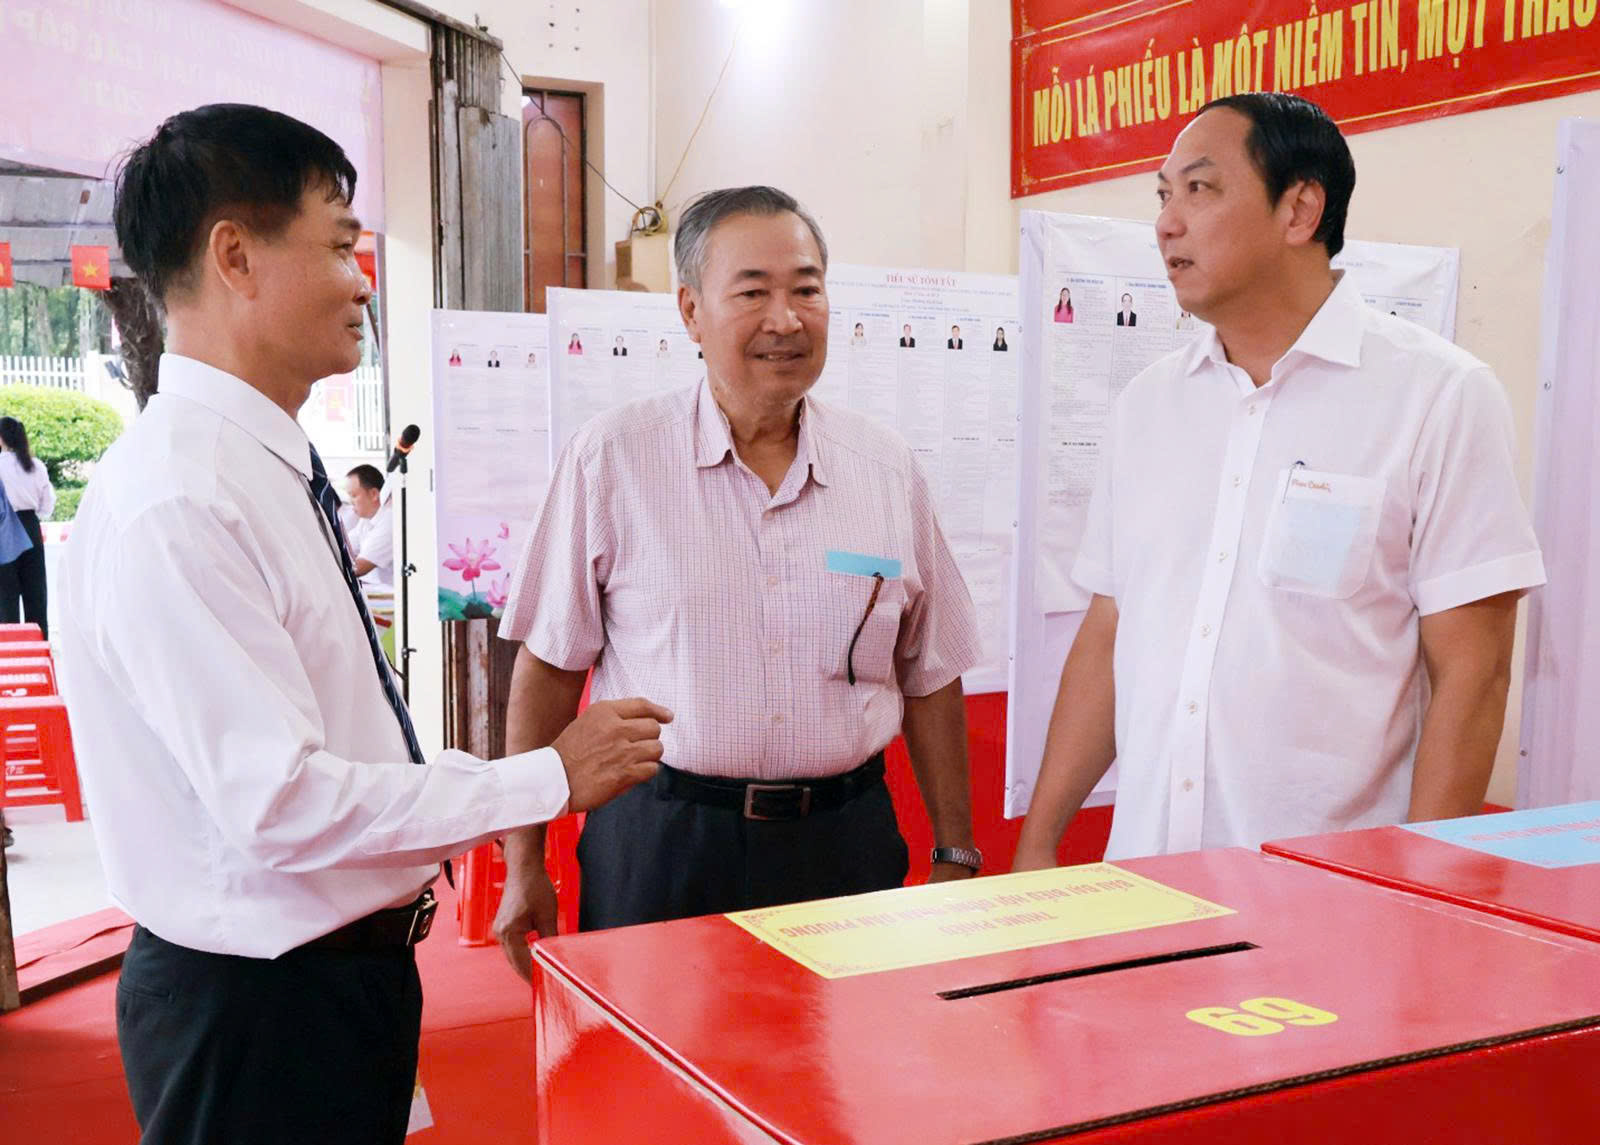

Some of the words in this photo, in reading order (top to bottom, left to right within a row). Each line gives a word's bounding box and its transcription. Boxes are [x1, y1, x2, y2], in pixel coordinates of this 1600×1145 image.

[1033, 66, 1072, 147] MỖI
[1075, 64, 1101, 137] LÁ
[1103, 39, 1171, 131] PHIẾU
[1177, 38, 1206, 115] LÀ
[1273, 0, 1343, 94] NIỀM
[1351, 0, 1408, 74] TIN,
[778, 919, 856, 938] PHƯỜNG
[1186, 997, 1338, 1036] 69
